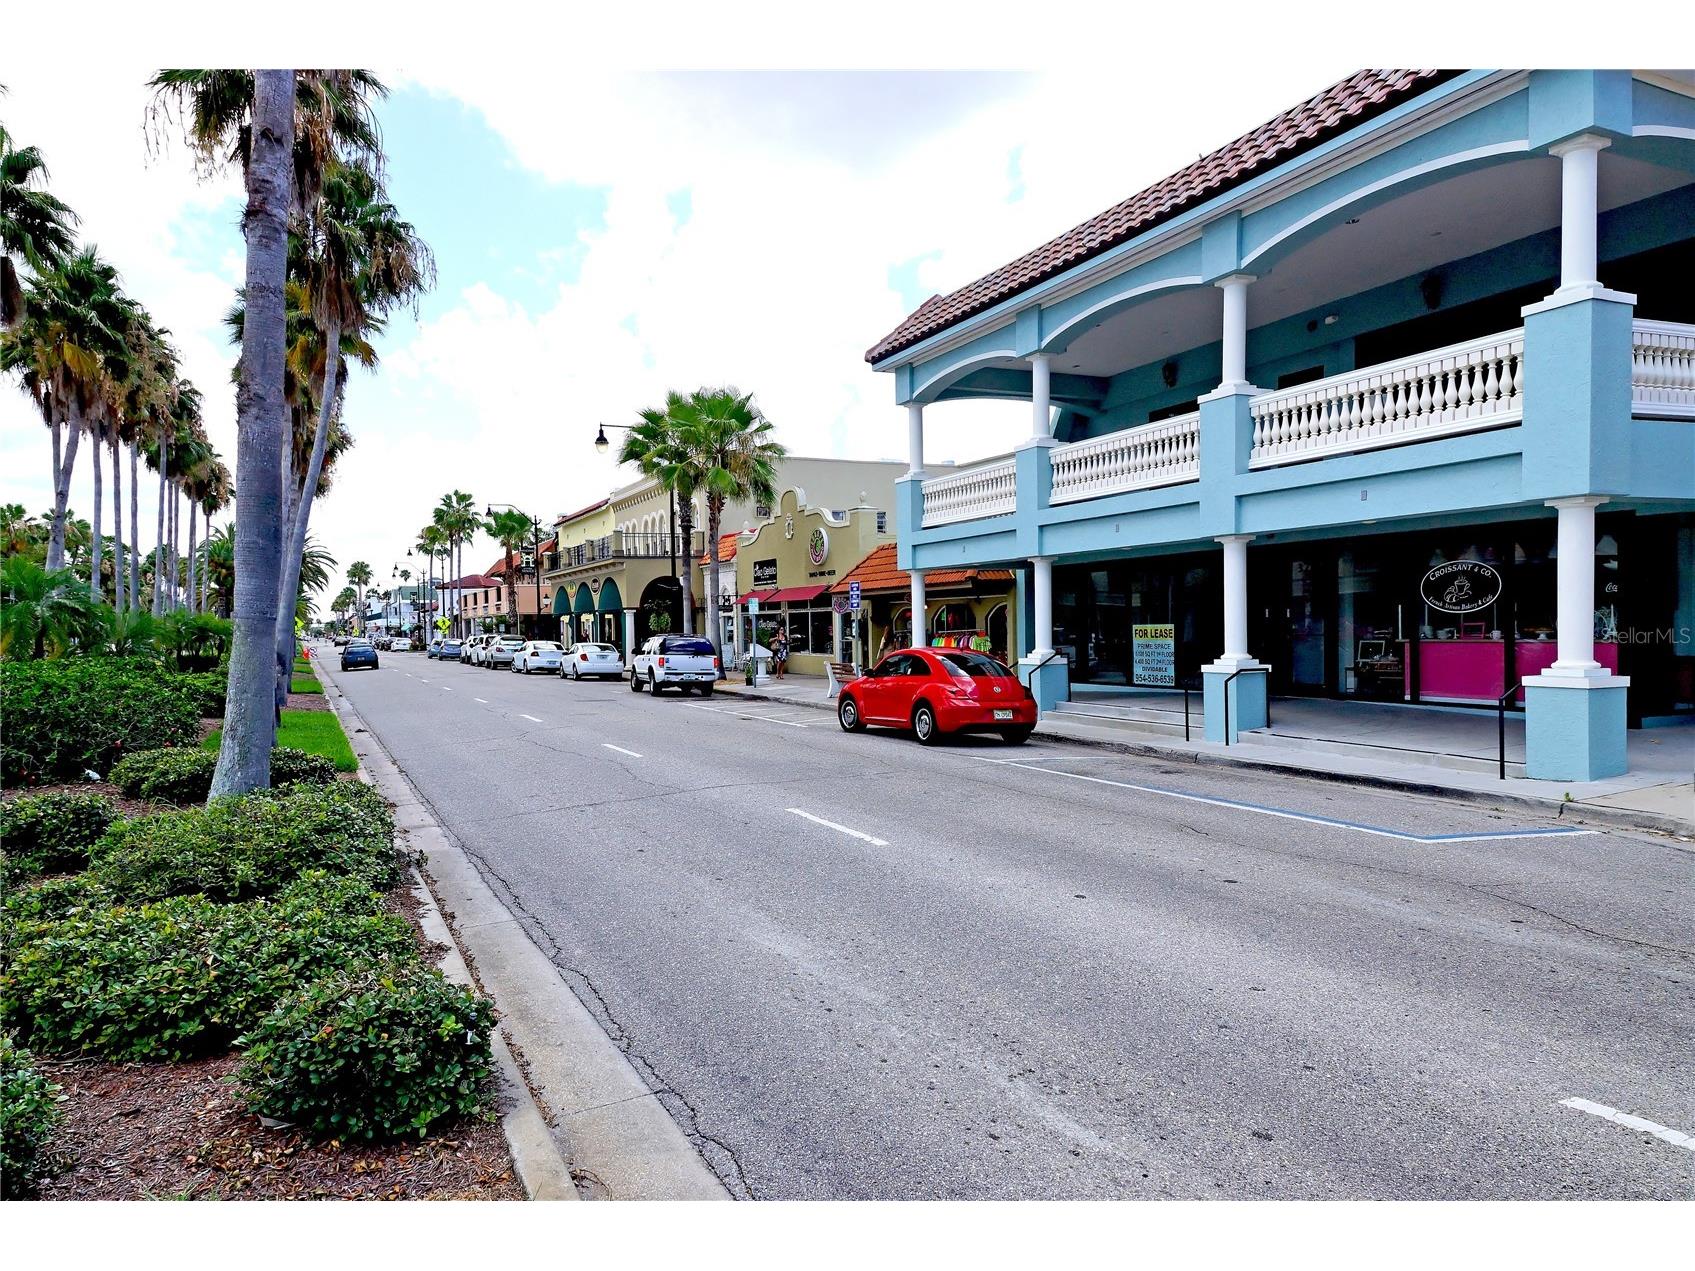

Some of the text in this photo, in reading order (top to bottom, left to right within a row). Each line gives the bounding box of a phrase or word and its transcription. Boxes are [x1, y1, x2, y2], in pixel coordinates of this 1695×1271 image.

[1429, 564, 1473, 580] CROISSANT
[1480, 567, 1492, 578] CO.
[1461, 602, 1478, 610] Bakery
[1135, 629, 1173, 638] FOR LEASE
[1135, 674, 1174, 683] 954-536-6539
